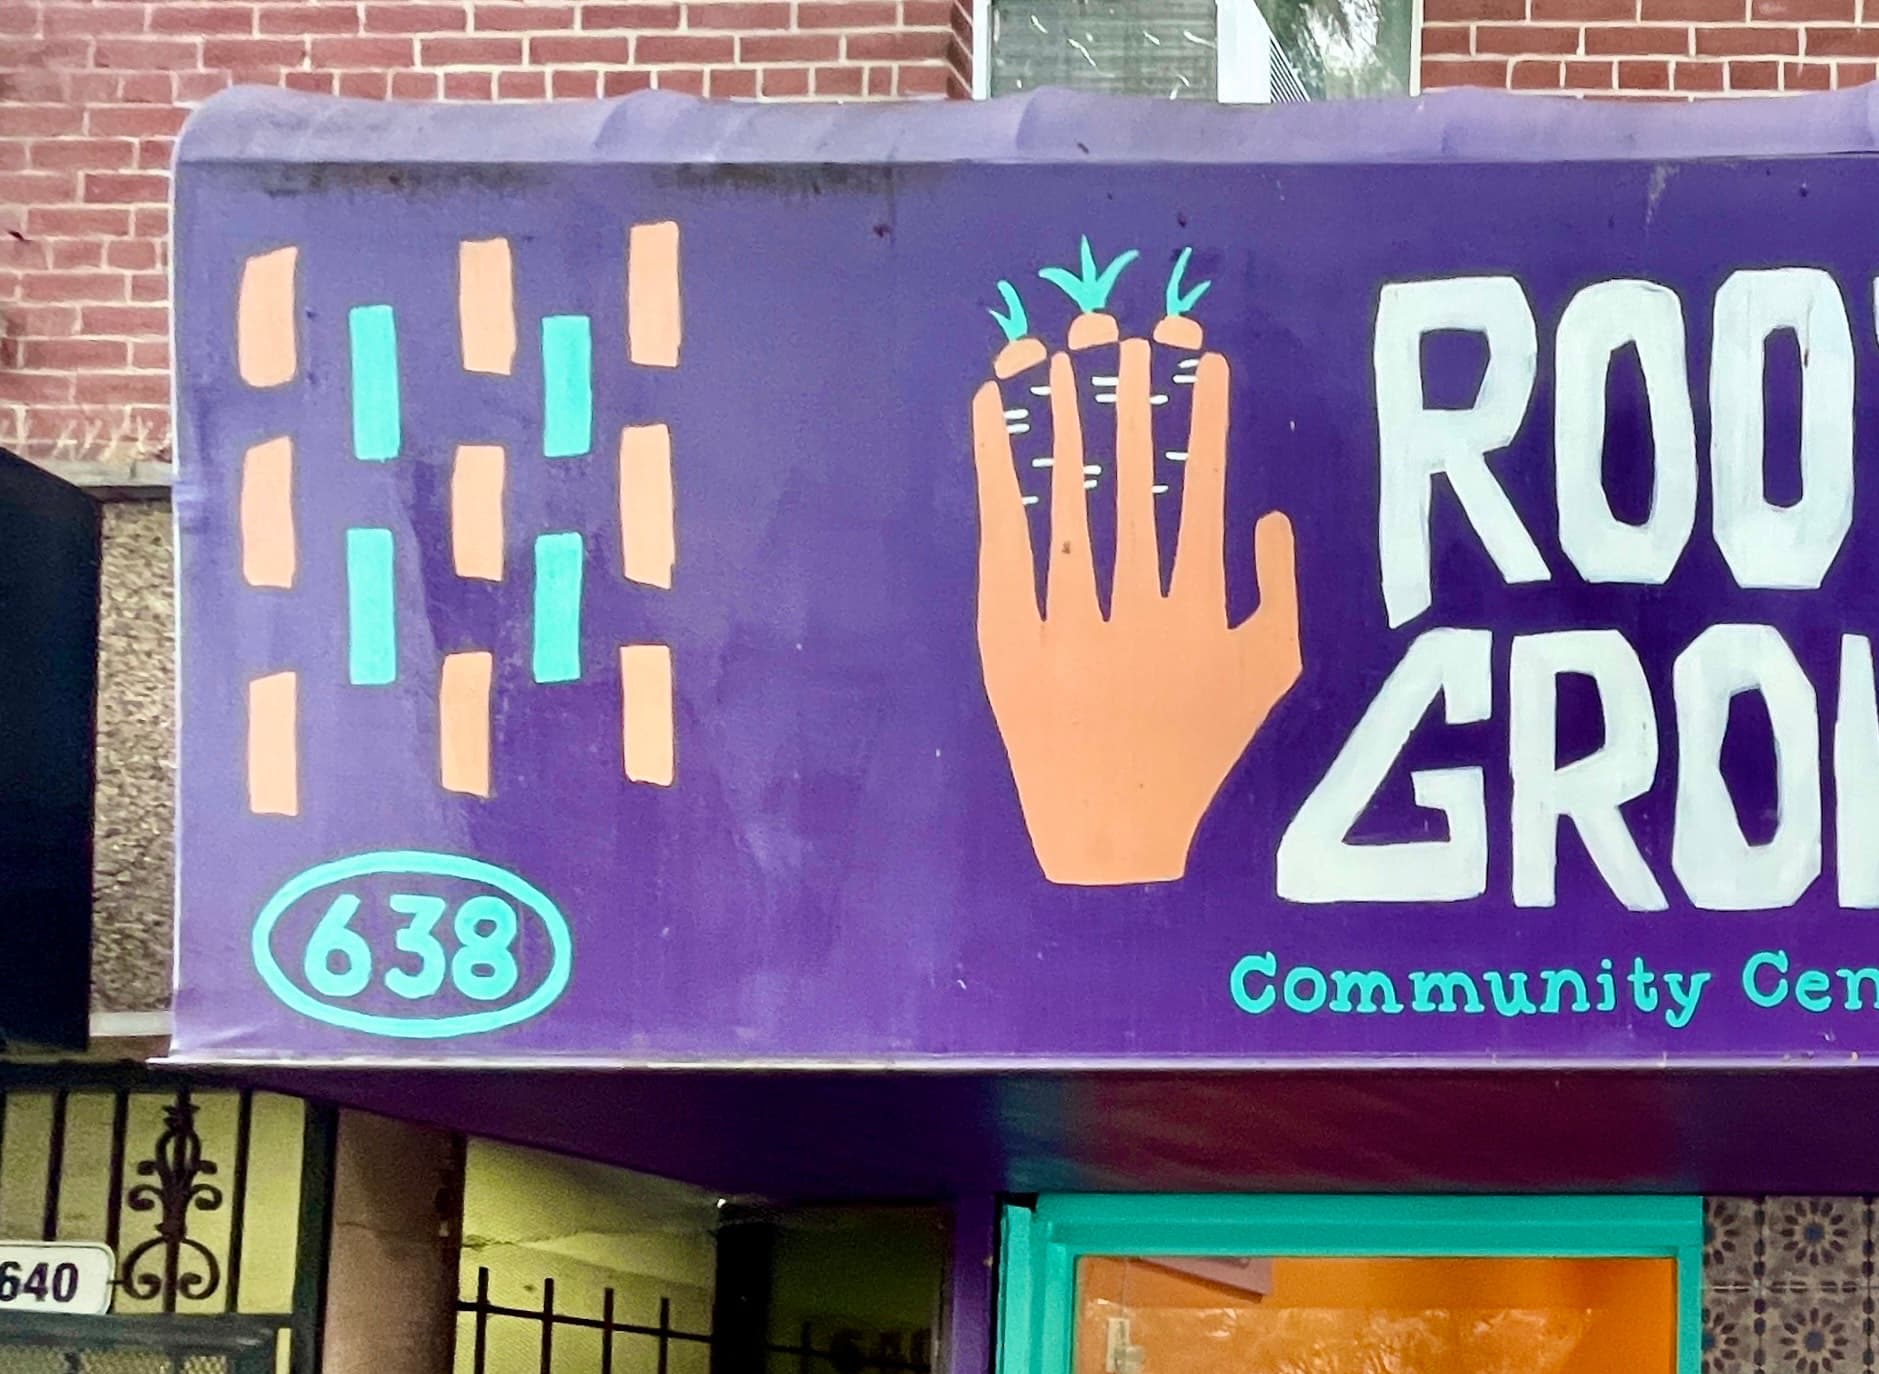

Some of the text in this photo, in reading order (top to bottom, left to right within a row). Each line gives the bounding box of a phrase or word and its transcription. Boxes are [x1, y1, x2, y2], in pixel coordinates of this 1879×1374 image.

[304, 894, 518, 1000] 638
[1229, 952, 1712, 1028] Community
[0, 1261, 79, 1303] 640
